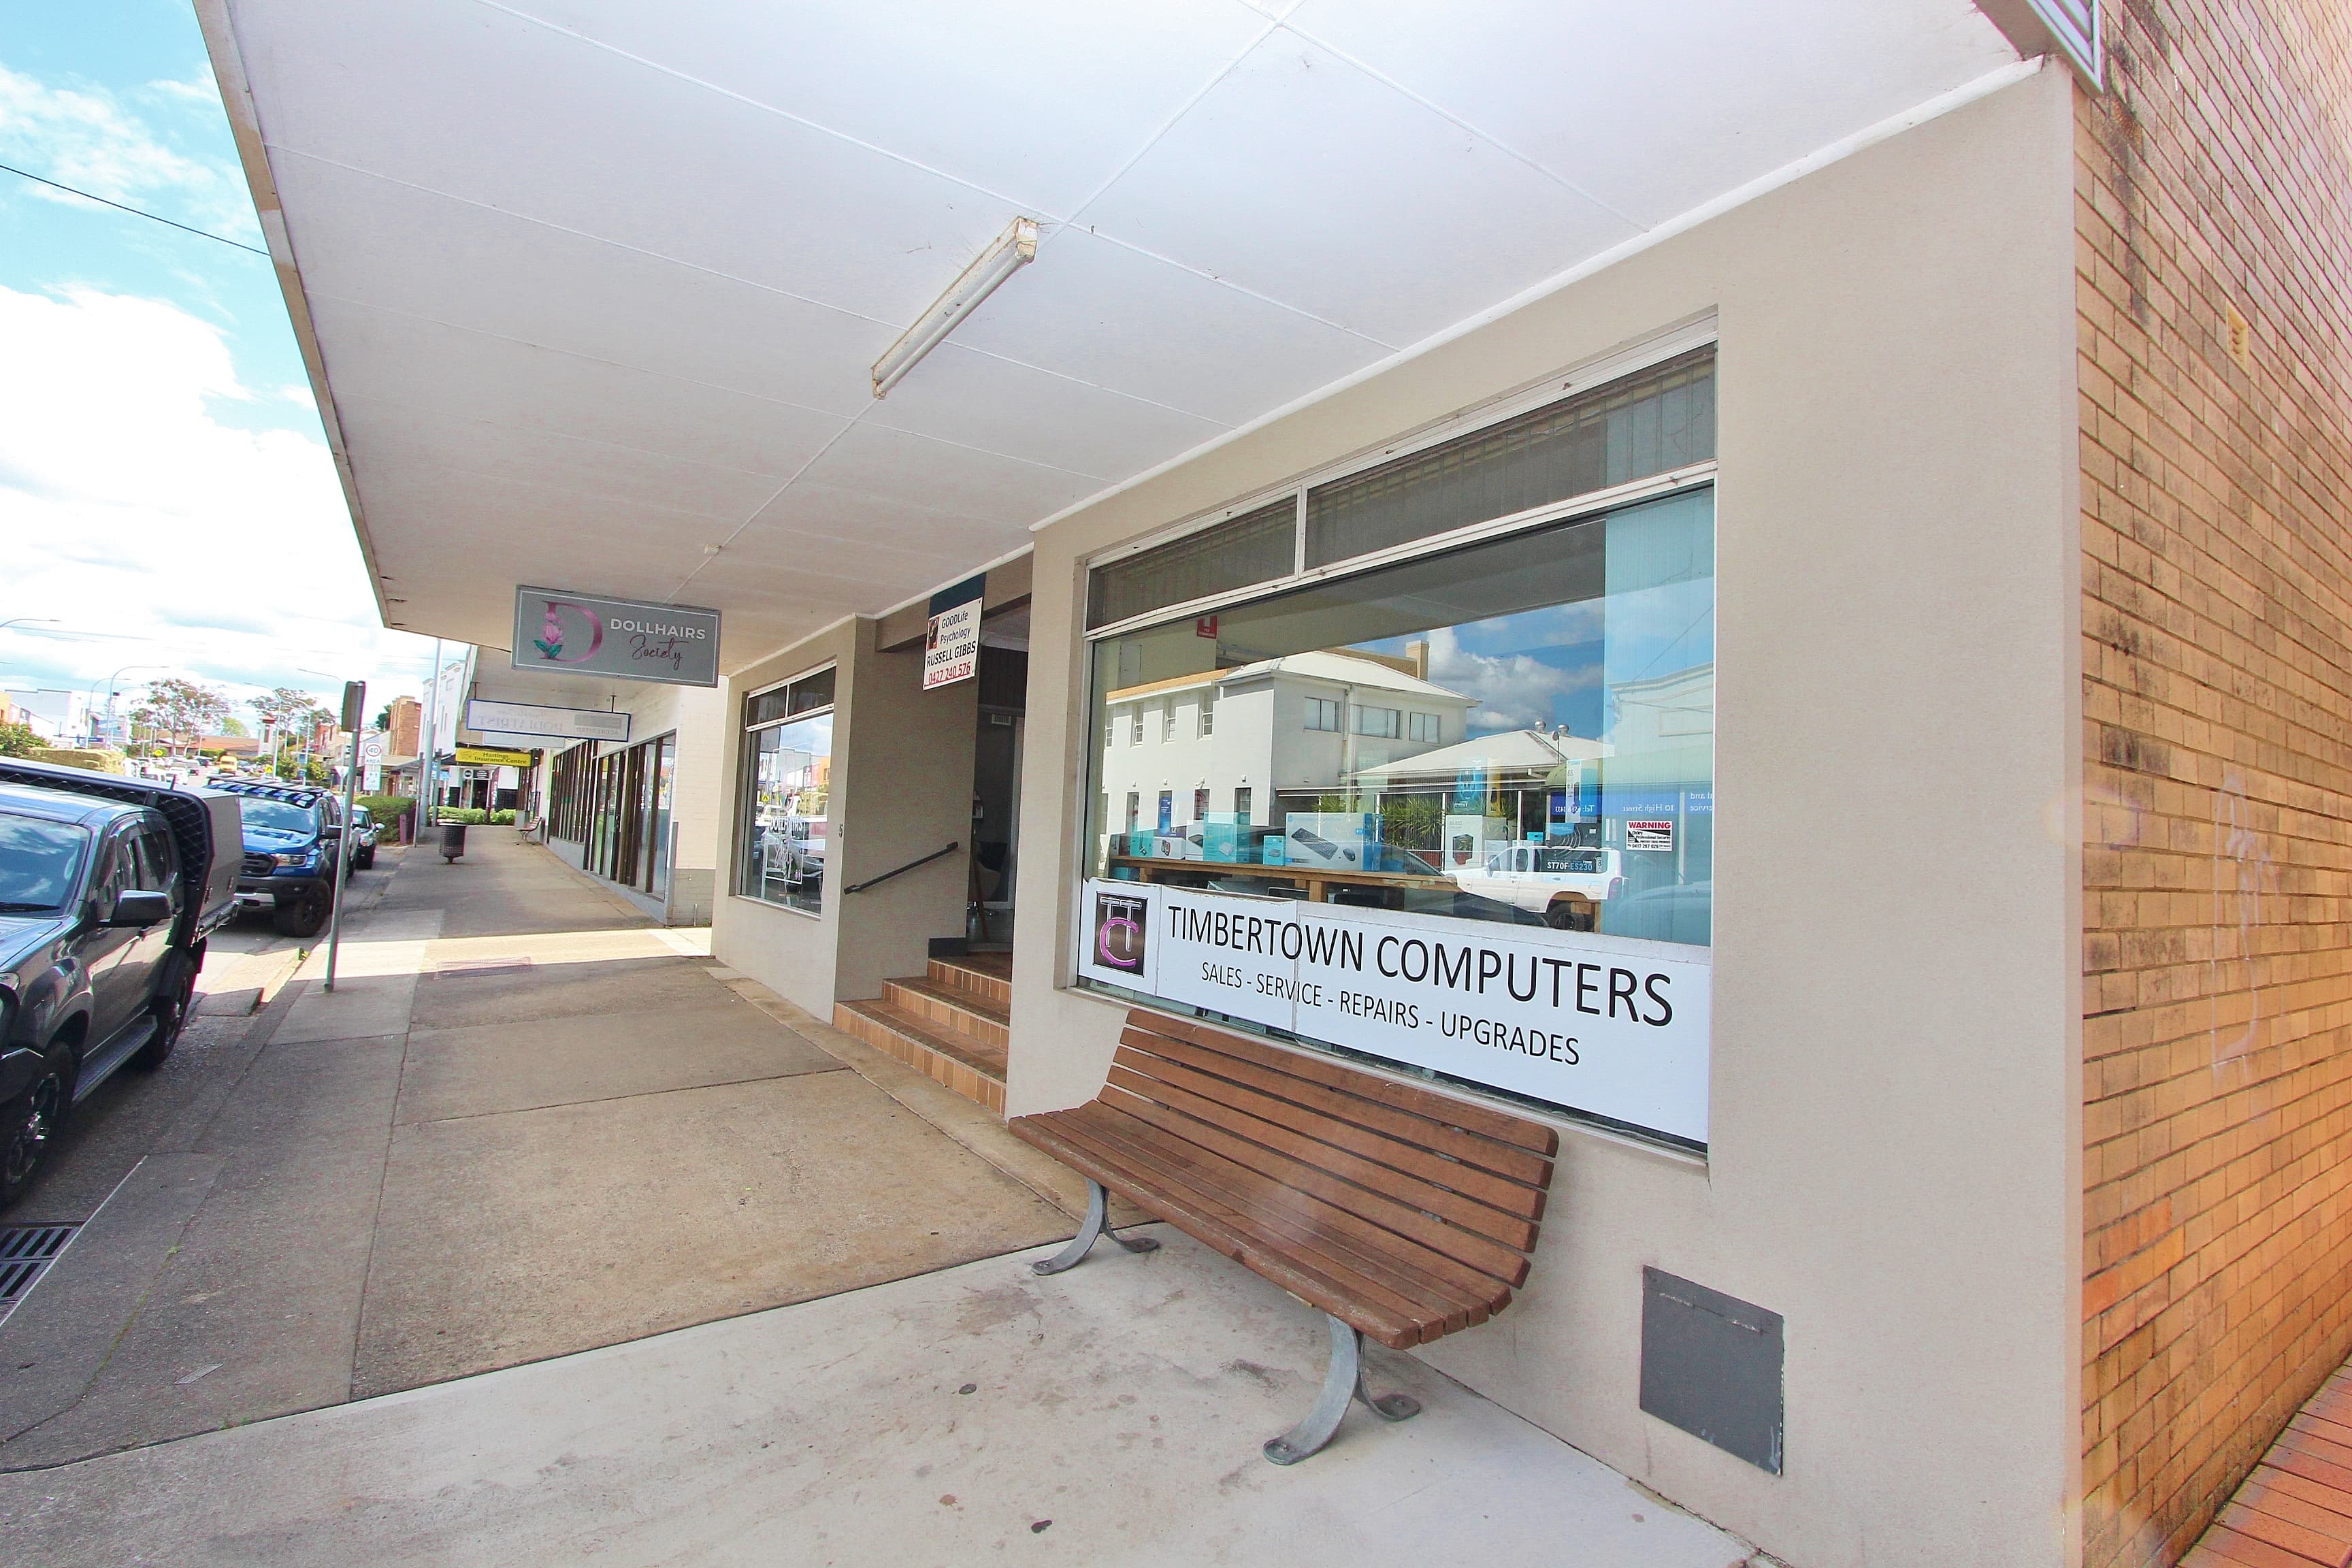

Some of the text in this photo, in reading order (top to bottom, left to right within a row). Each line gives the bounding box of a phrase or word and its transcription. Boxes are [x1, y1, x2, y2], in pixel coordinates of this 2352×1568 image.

[610, 618, 706, 640] DOLLHAIRS
[942, 610, 968, 629] GOODLife
[941, 627, 971, 645] Psychology
[630, 634, 689, 670] Society
[927, 640, 976, 668] RUSSELL GIBBS
[929, 662, 971, 685] 0427 240 576
[483, 751, 509, 760] Hastings
[838, 823, 843, 838] 5
[1547, 861, 1592, 871] ST70F-ES230
[1168, 906, 1673, 1026] TIMBERTOWN COMPUTERS
[1201, 962, 1243, 989] SALES
[1256, 973, 1322, 1007] SERVICE
[1340, 990, 1419, 1029] REPAIRS
[1441, 1011, 1580, 1065] UPGRADES
